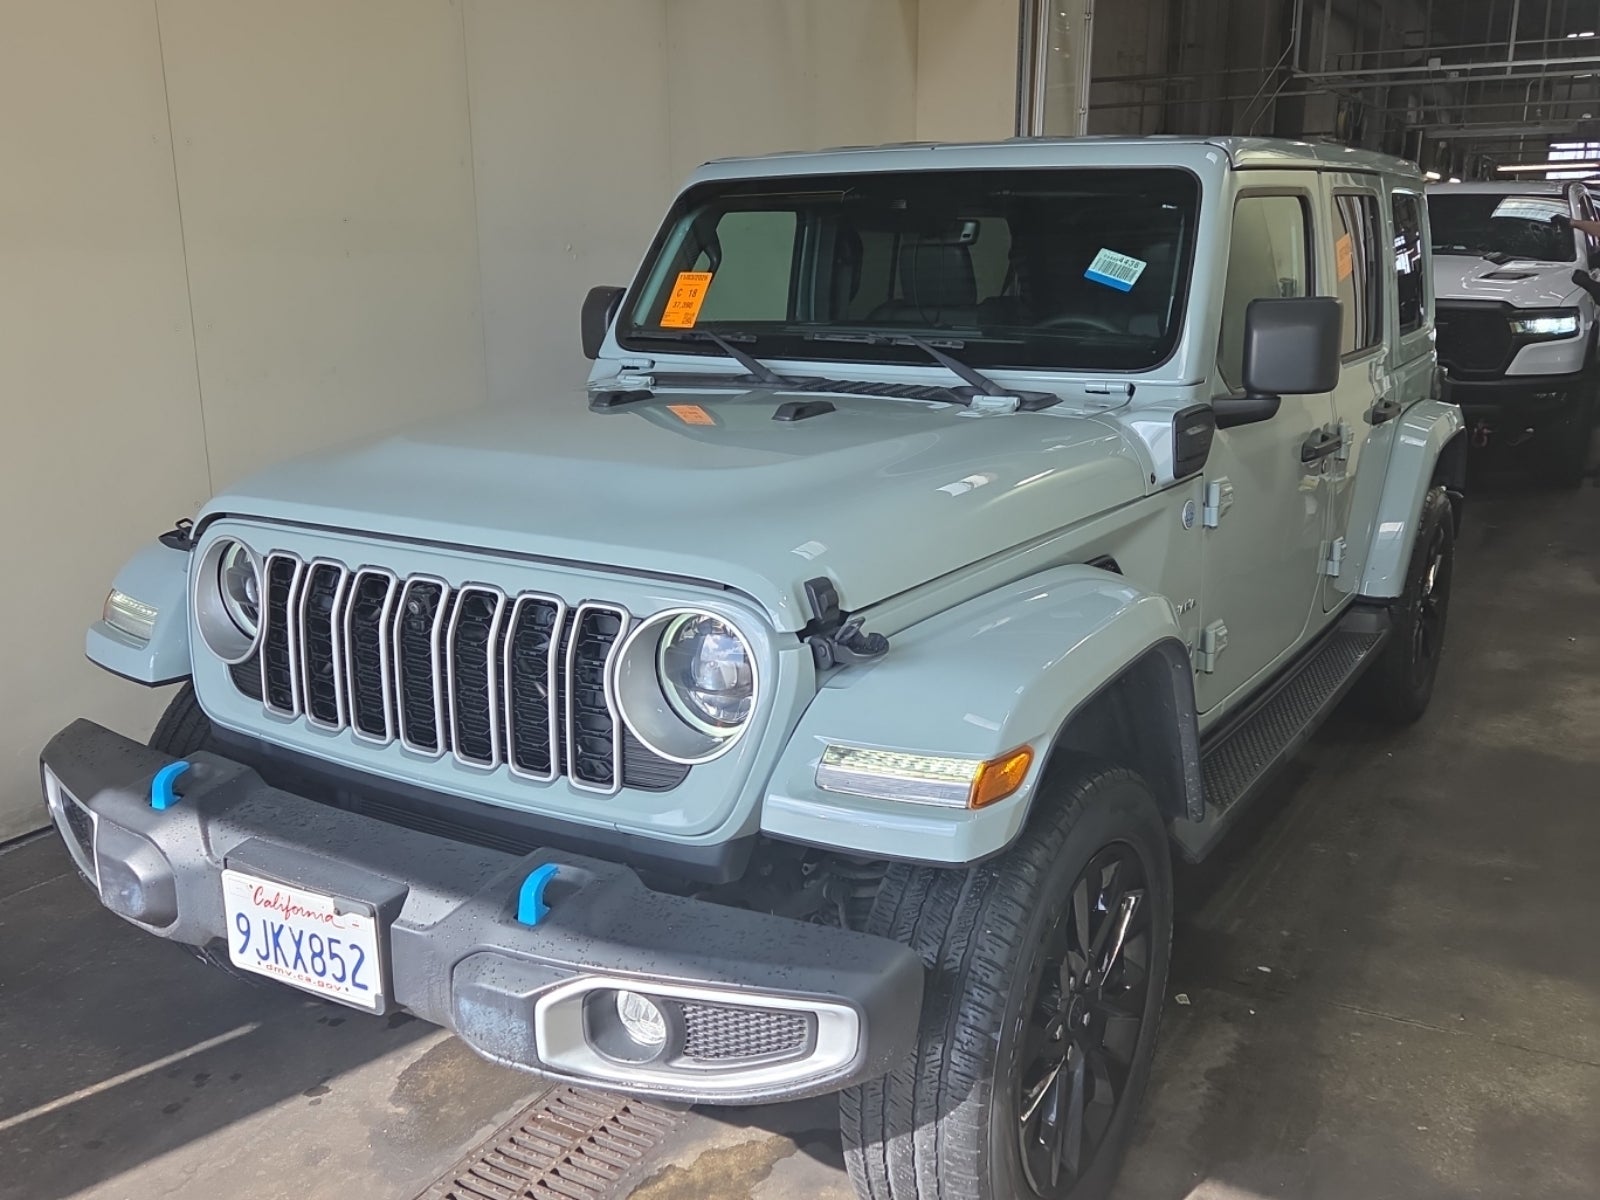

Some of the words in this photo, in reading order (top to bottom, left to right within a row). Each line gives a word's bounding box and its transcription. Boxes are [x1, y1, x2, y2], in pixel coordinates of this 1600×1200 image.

[676, 288, 683, 298] C
[688, 288, 698, 298] 18
[253, 885, 346, 930] California
[235, 912, 369, 991] 9JKX852
[266, 963, 342, 993] dmv.ca.gov
